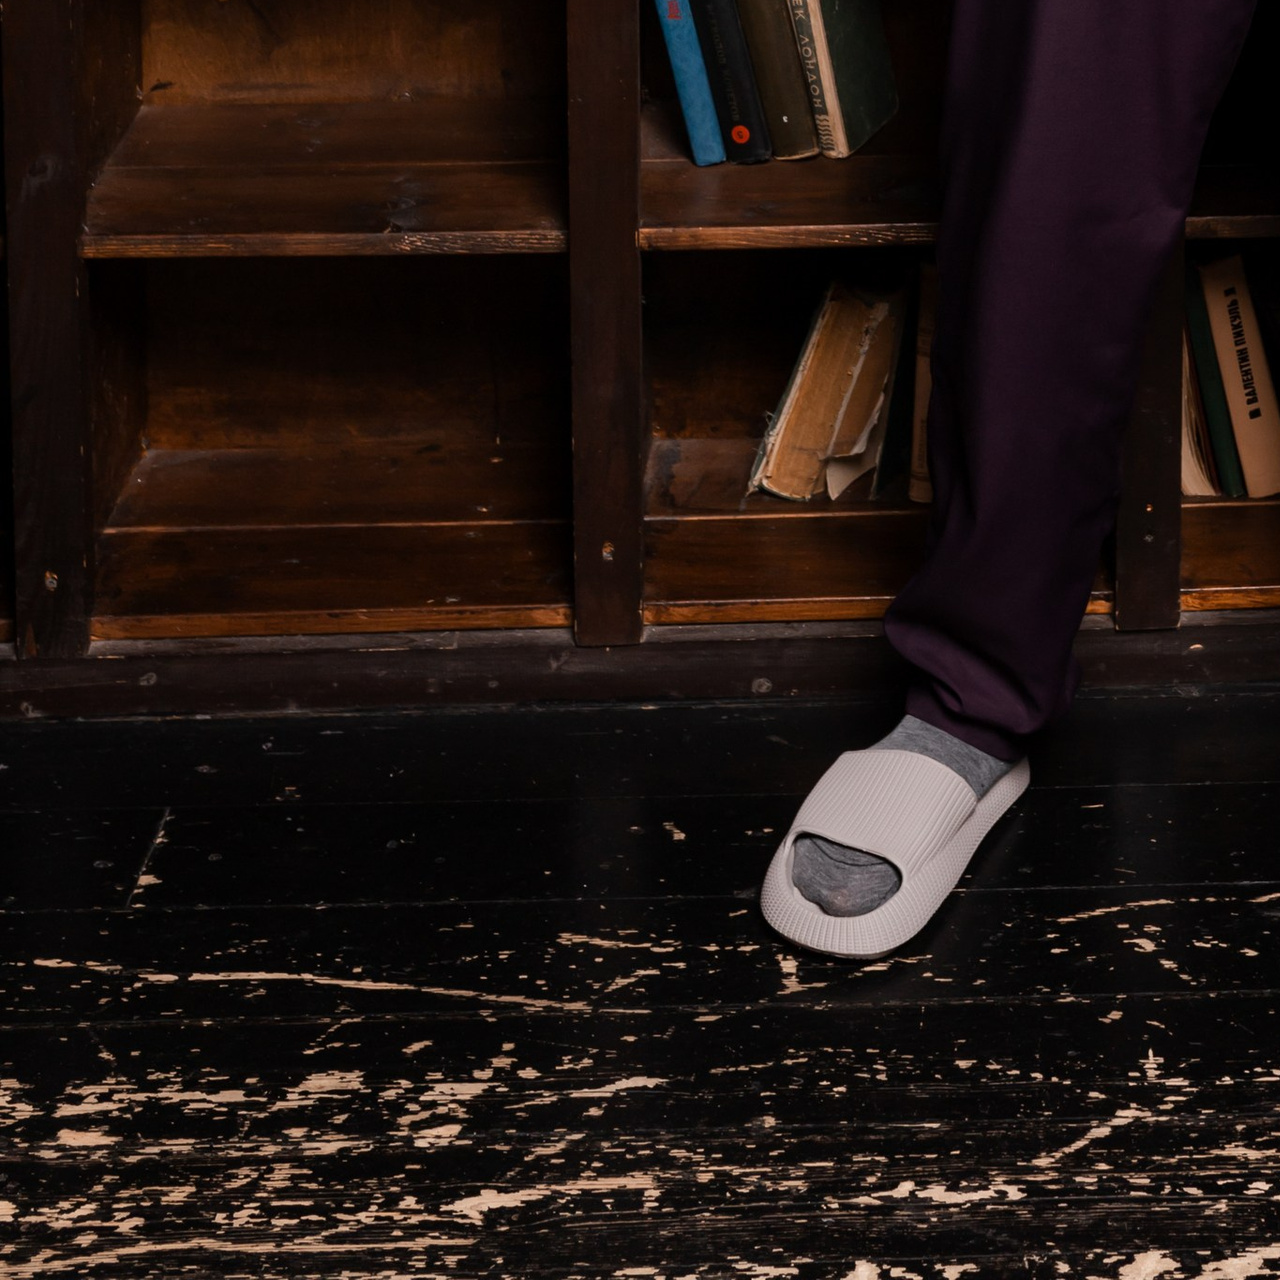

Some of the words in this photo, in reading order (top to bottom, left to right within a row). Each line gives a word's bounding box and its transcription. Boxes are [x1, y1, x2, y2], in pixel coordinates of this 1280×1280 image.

[798, 31, 824, 110] ЛОНДОН
[1224, 297, 1248, 346] ПИКУЛЬ
[1234, 345, 1260, 405] ВАЛЕНТИН
